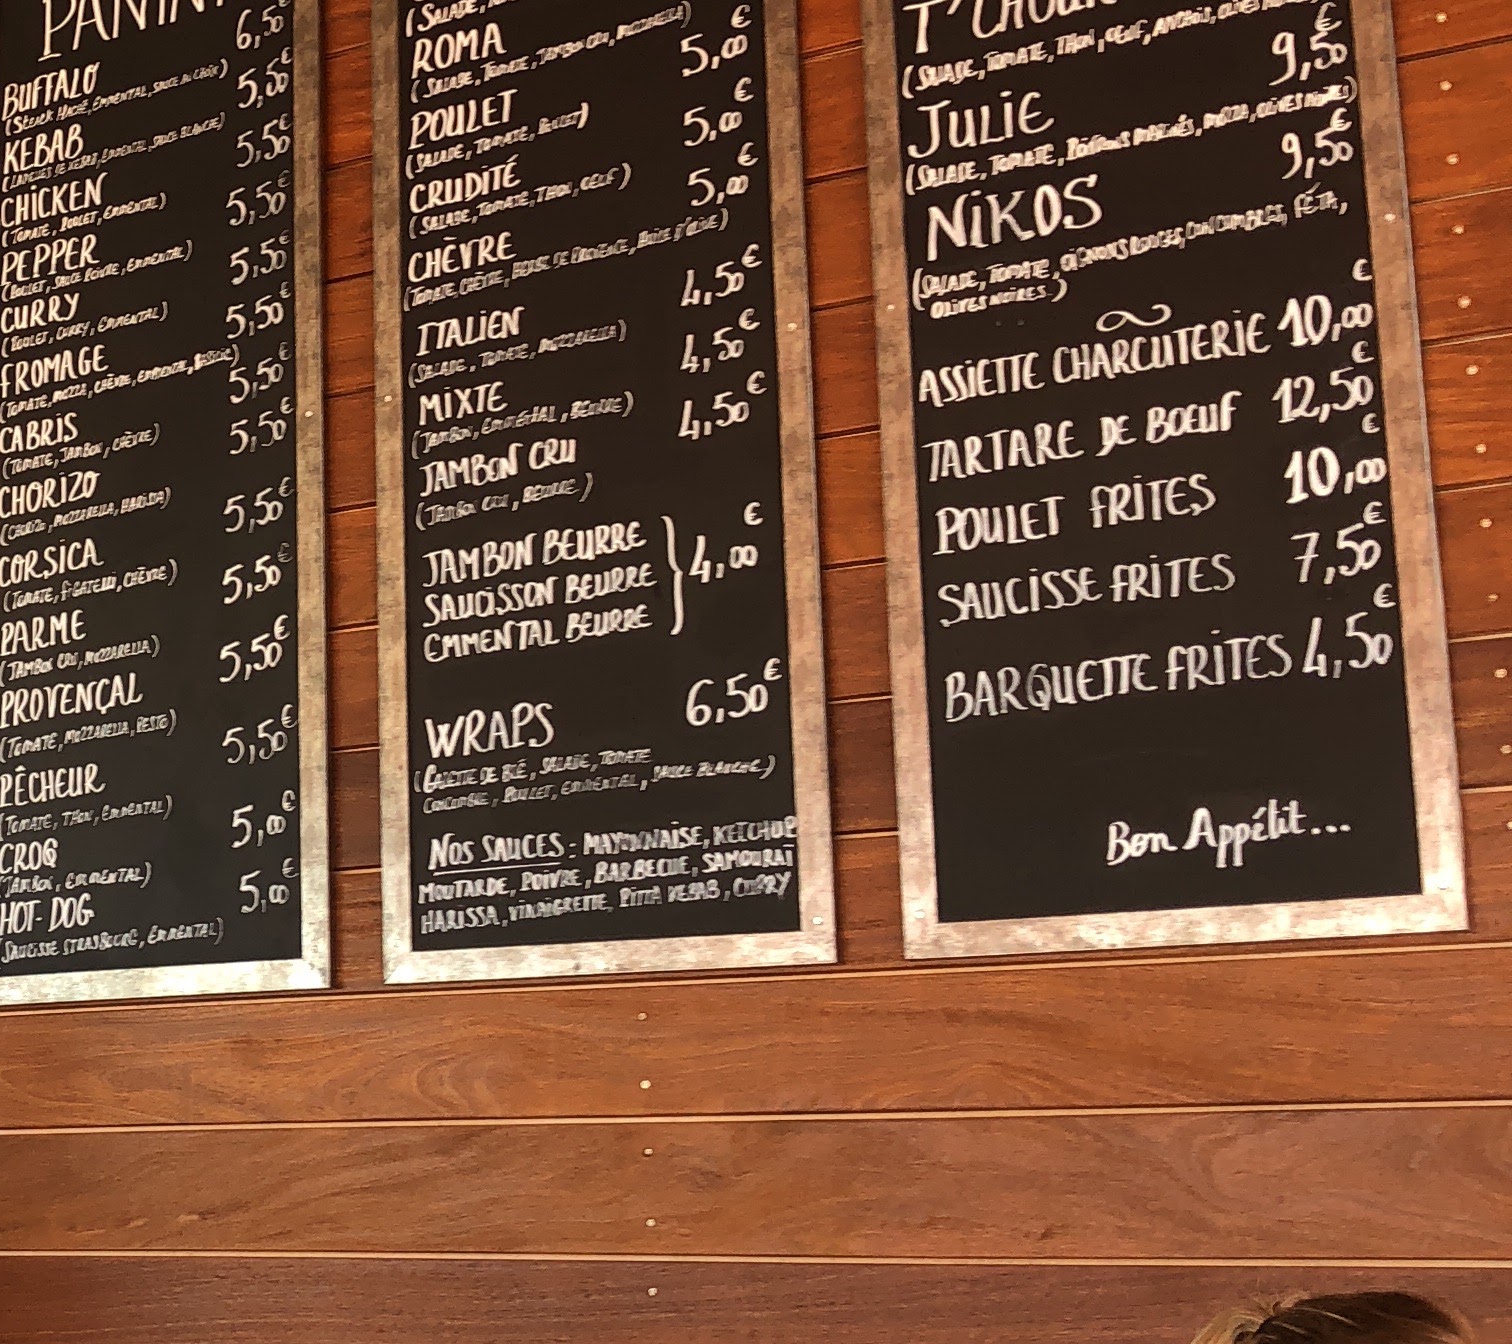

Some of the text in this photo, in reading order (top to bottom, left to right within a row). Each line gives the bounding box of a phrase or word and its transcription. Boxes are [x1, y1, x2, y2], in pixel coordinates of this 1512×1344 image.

[411, 23, 507, 79] ROMA
[2, 61, 100, 121] BUFFALO
[408, 89, 519, 149] POULET
[3, 123, 84, 174] KEBAB
[907, 90, 1055, 159] JULIE
[0, 172, 108, 228] CHICKEN
[409, 154, 521, 214] CRUDITÉ
[926, 174, 1103, 262] NIKOS
[0, 233, 100, 286] PEPPER
[0, 292, 80, 334] CURRY
[417, 306, 525, 356] ITALIEN
[0, 344, 110, 398] FROMAGE
[918, 310, 1272, 408] ASSIETTE CHARCUTERIE
[418, 381, 509, 427] MIXTE
[419, 438, 578, 498] JAMBON CRU
[921, 421, 1085, 482] TARTARE
[1096, 415, 1137, 456] DE
[931, 473, 1217, 556] POULET FRITES
[422, 521, 647, 589] JAMBON BEURRE
[422, 563, 658, 628] SAUCISSON BEURRE
[937, 553, 1237, 627] SAUCISSE FRITES
[0, 609, 87, 657] PARME
[423, 603, 654, 663] EMMENTAL BEURRE
[944, 630, 1292, 723] BARQUETTE FRITES
[424, 702, 555, 759] WRAPS
[1107, 821, 1178, 865] Bon
